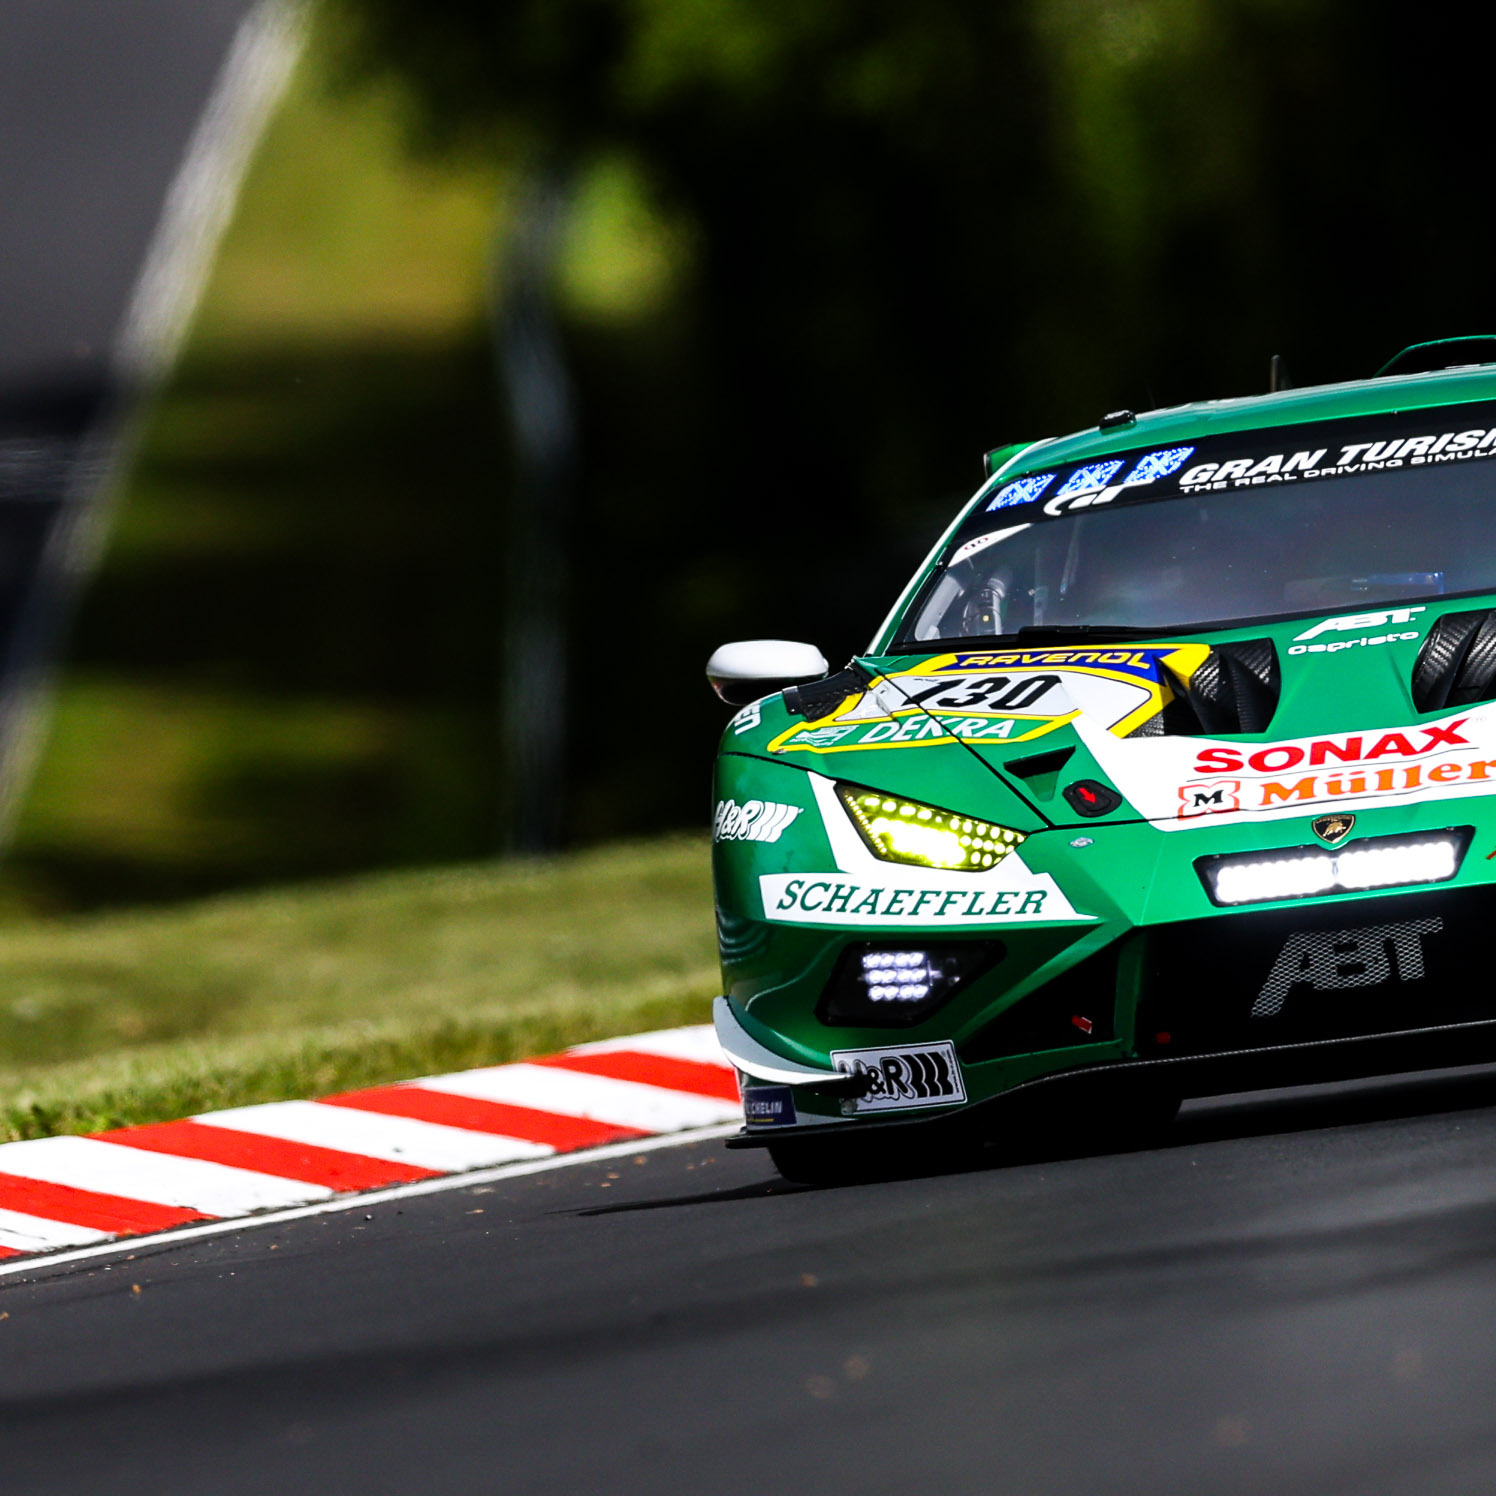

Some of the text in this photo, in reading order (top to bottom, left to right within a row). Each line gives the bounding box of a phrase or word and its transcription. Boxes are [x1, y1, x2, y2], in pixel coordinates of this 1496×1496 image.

[1179, 448, 1328, 486] GRAN
[1180, 481, 1228, 493] THE
[1235, 472, 1297, 487] REAL
[1304, 459, 1404, 479] DRIVING
[1292, 606, 1427, 642] ABT
[959, 651, 1151, 670] RAVENOL
[858, 715, 1016, 743] DEKRA
[1194, 718, 1470, 773] SONAX
[776, 880, 1048, 915] SCHAEFFLER
[1251, 917, 1444, 1017] ABT
